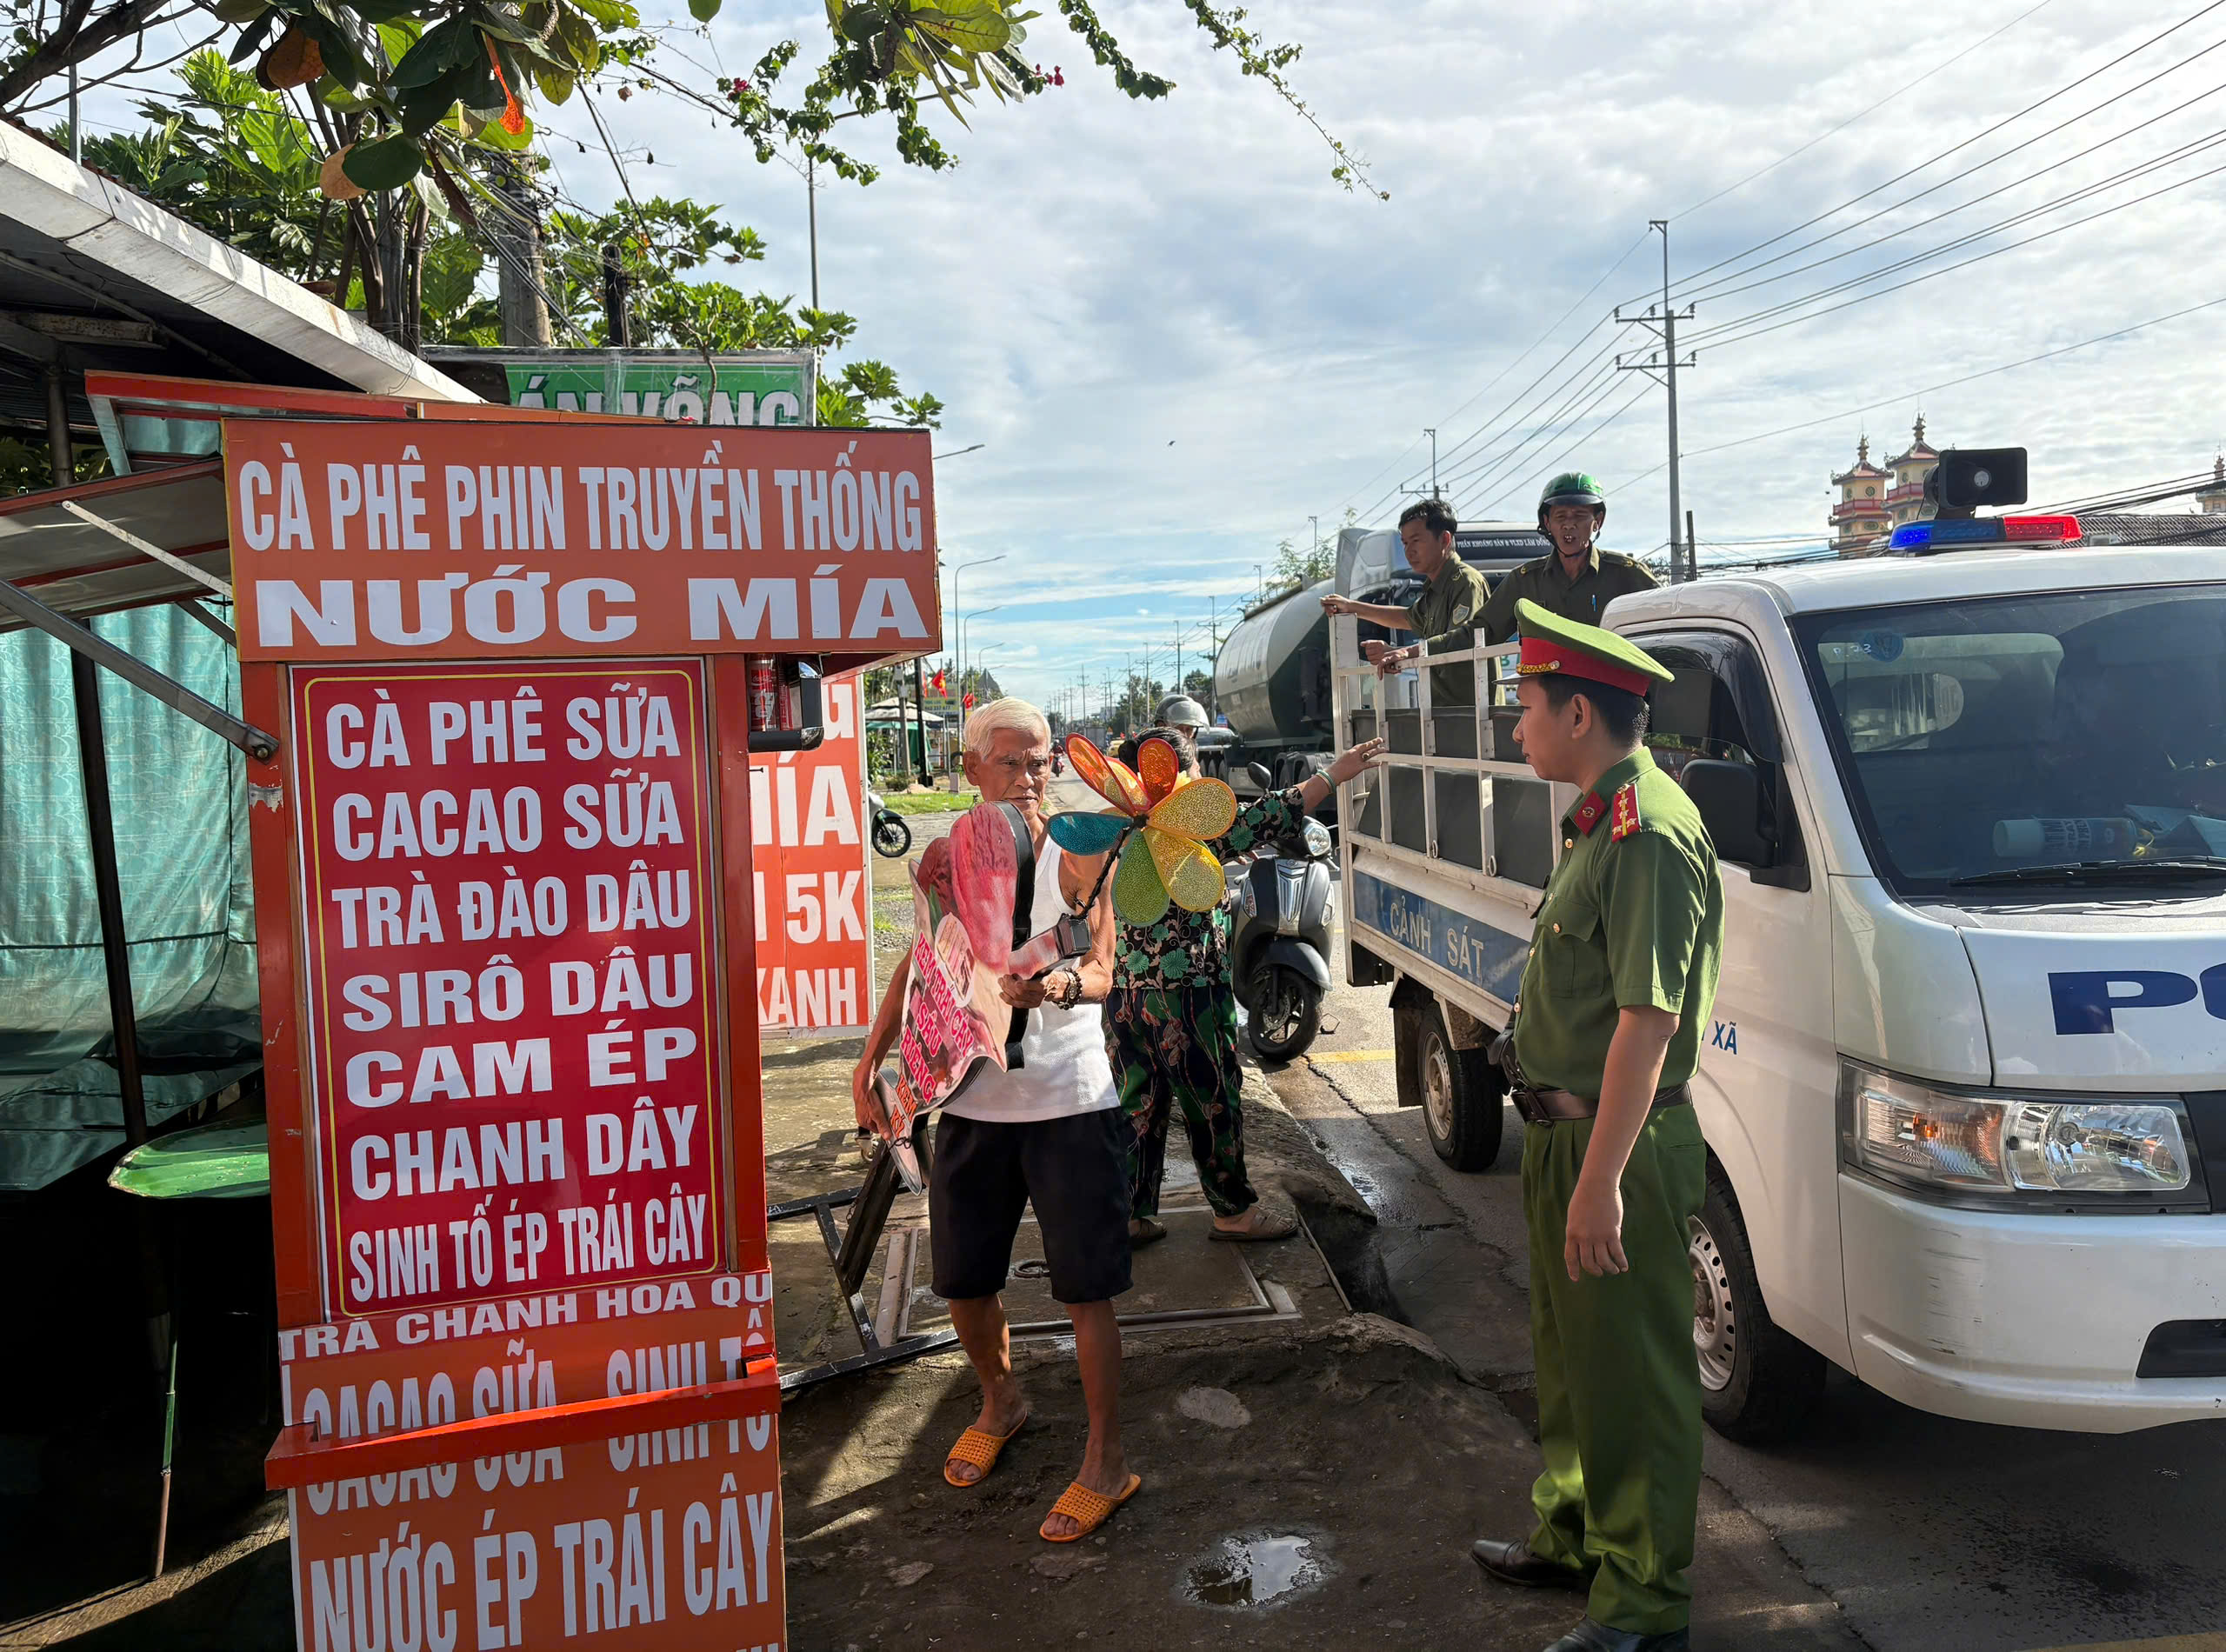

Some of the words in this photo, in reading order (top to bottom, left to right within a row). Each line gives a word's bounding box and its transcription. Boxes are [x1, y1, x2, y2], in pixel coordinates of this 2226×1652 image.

[239, 442, 315, 551] CÀ
[327, 444, 430, 550] PHÊ
[445, 465, 566, 550] PHIN
[579, 439, 763, 551] TRUYỀN
[773, 440, 922, 552] THỐNG
[256, 563, 637, 647] NƯỚC
[687, 563, 928, 640] MÍA
[326, 688, 410, 769] CÀ
[429, 685, 546, 765] PHÊ
[566, 682, 681, 761] SỮA
[333, 786, 543, 862] CACAO
[563, 768, 684, 849] SỮA
[331, 870, 444, 949] TRÀ
[457, 865, 568, 942] ĐÀO
[586, 859, 691, 933] DÂU
[786, 870, 865, 943] 5K
[1390, 895, 1431, 954] CẢNH
[1447, 925, 1484, 978] SÁT
[343, 954, 524, 1032] SIRÔ
[550, 945, 693, 1016] DÂU
[2048, 963, 2226, 1035] P
[345, 1037, 552, 1109] CAM
[587, 1019, 696, 1087] ÉP
[1711, 1020, 1737, 1055] XÃ
[350, 1117, 565, 1202] CHANH
[585, 1096, 698, 1176] DÂY
[350, 1223, 440, 1302] SINH
[449, 1194, 493, 1289] TỐ
[503, 1199, 548, 1283] ÉP
[558, 1188, 634, 1276] TRÁI
[644, 1182, 706, 1265] CÂY
[396, 1294, 578, 1344] CHANH
[596, 1281, 694, 1319] HOA
[310, 1522, 457, 1652] NƯỚC
[474, 1509, 537, 1650] ÉP
[554, 1488, 667, 1637] TRÁI
[683, 1472, 774, 1616] CÂY
